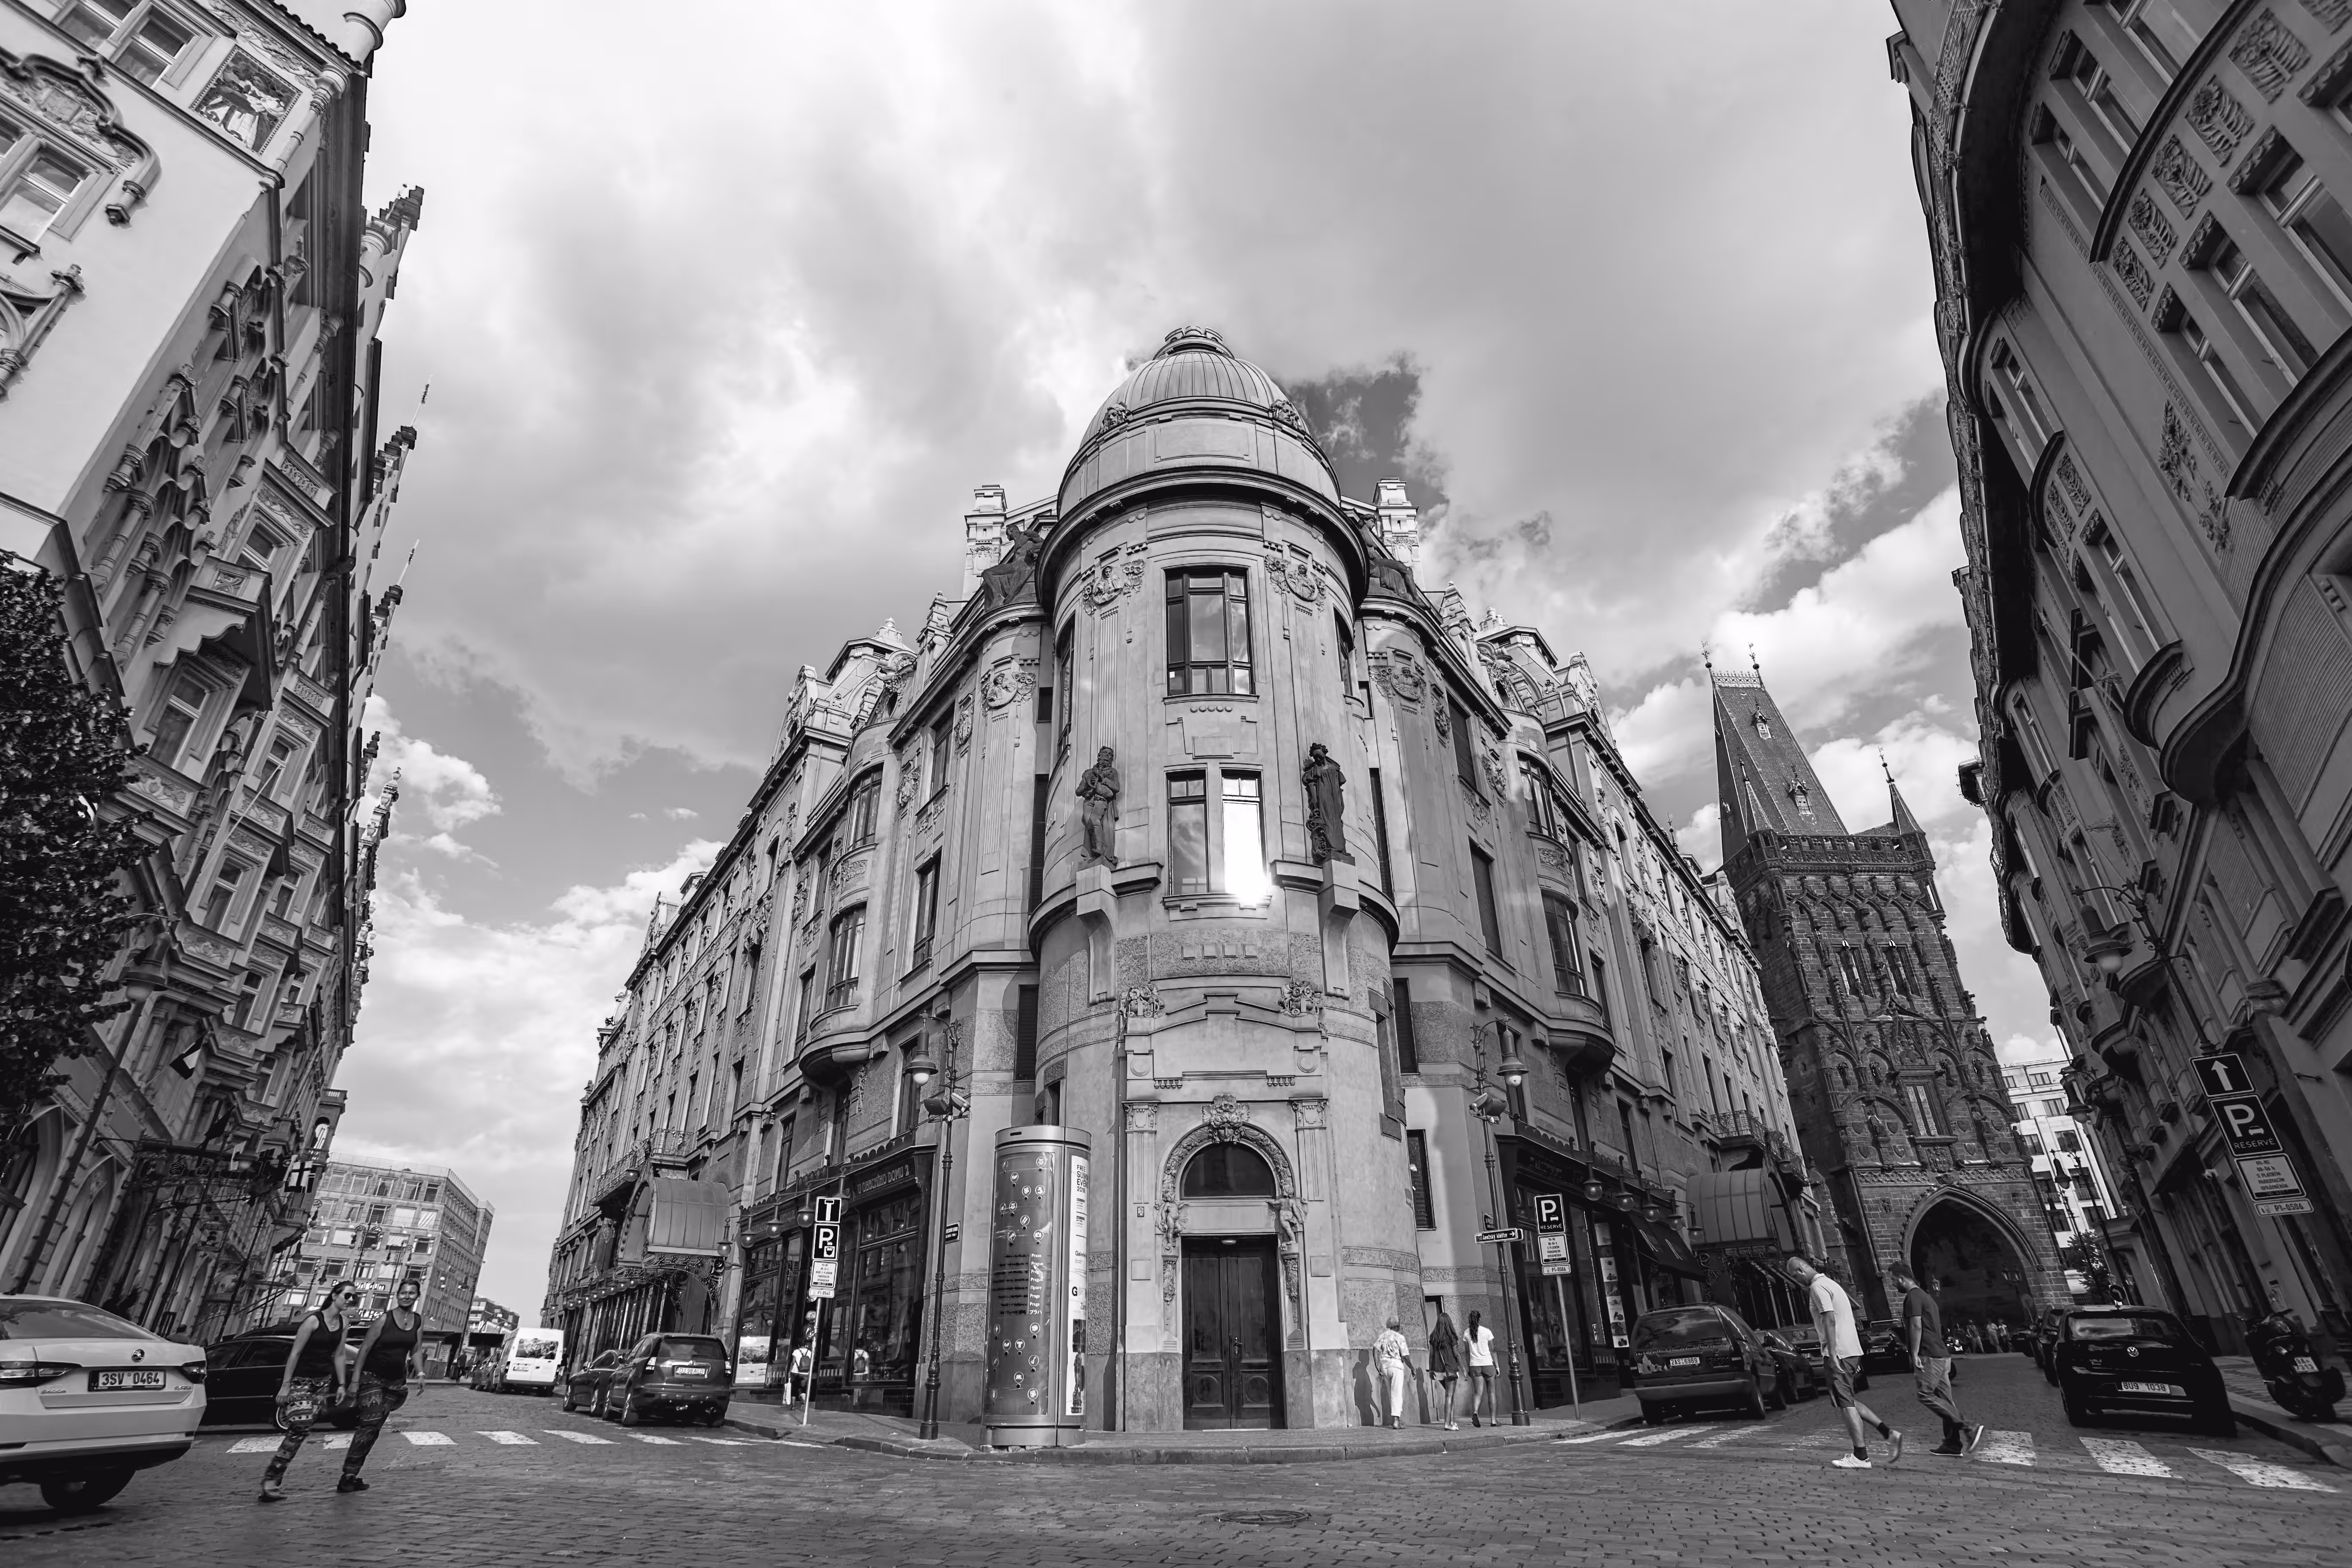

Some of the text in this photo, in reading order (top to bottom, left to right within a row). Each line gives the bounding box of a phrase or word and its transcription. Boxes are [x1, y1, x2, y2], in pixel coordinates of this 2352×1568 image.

[2223, 1104, 2255, 1137] P
[888, 1166, 903, 1183] DOMU
[905, 1164, 910, 1176] 2
[1077, 1164, 1086, 1173] FREE
[1540, 1199, 1557, 1222] P
[2273, 1203, 2304, 1212] P1-0506
[818, 1228, 834, 1249] P
[1072, 1286, 1078, 1296] G
[101, 1372, 160, 1385] 3SV 0464
[2123, 1382, 2166, 1391] 8U9 1038
